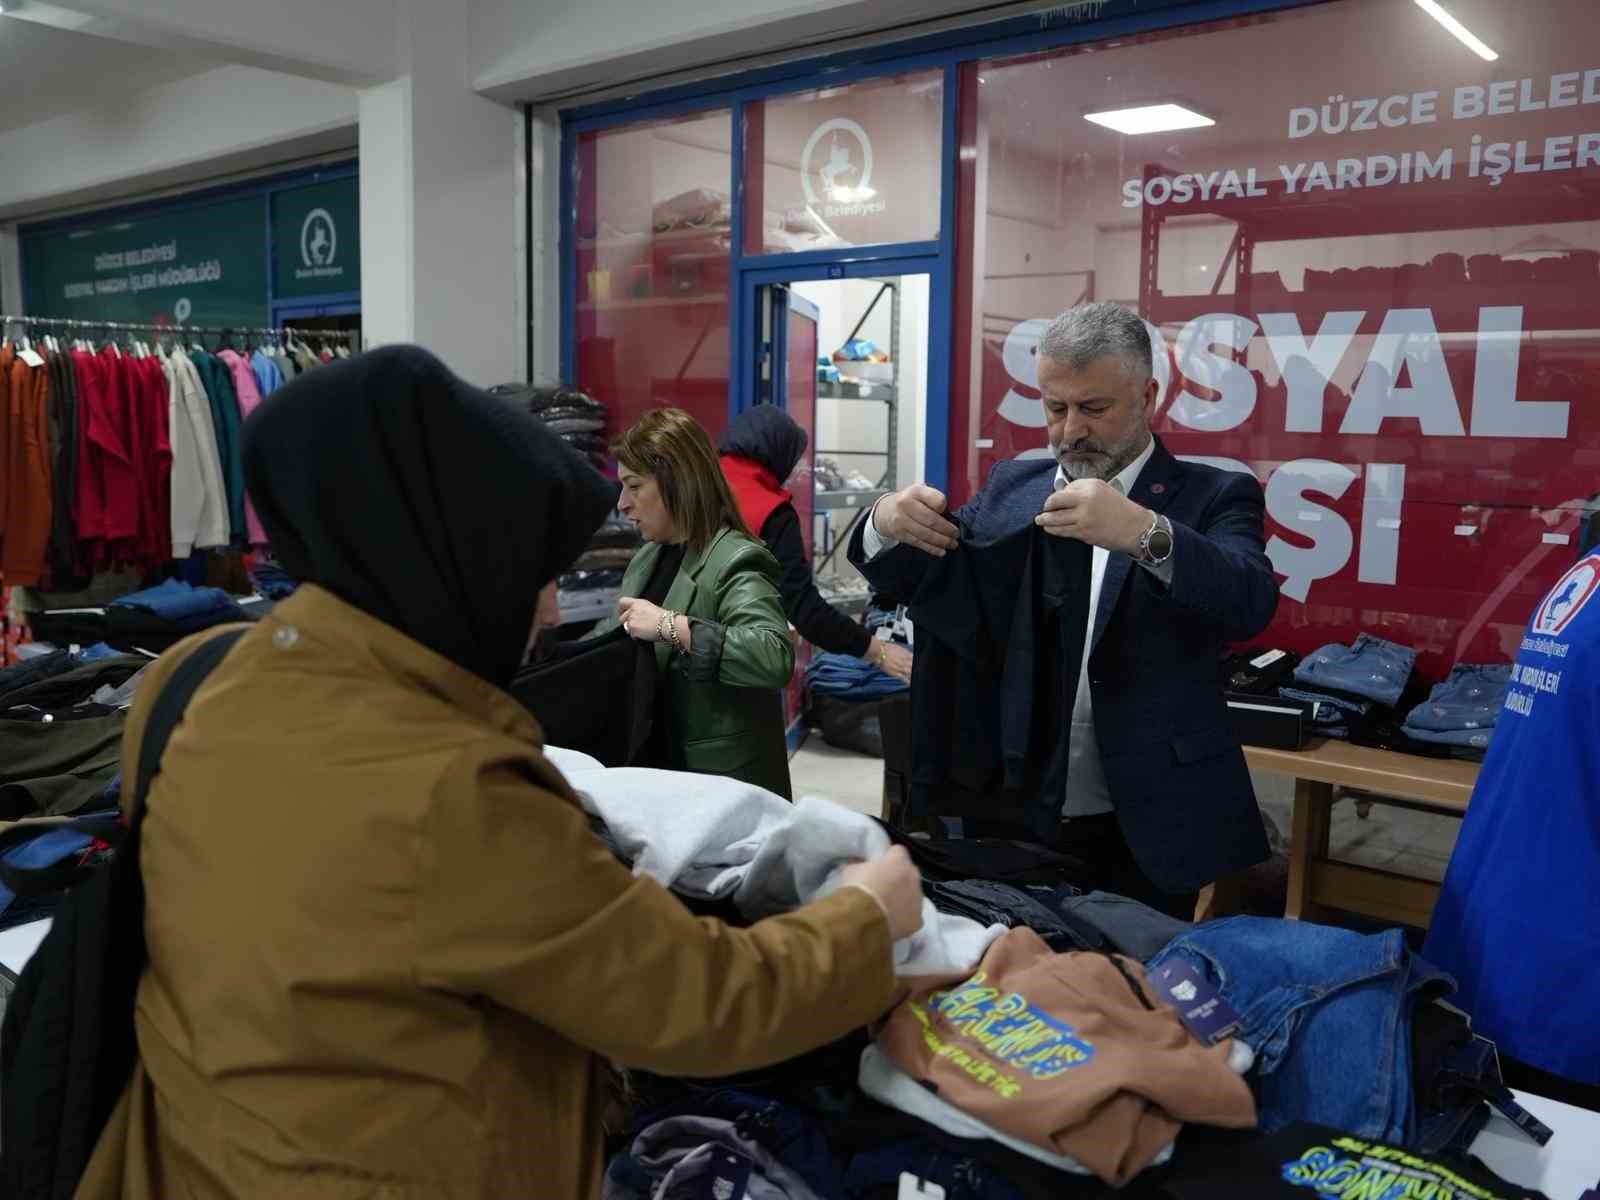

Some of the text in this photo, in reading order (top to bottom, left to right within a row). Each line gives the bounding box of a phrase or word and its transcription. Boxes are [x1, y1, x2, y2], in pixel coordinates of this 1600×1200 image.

[1288, 90, 1440, 139] DÜZCE
[1121, 132, 1600, 209] SOSYAL YARDIM İŞLER
[997, 305, 1570, 439] SSYAL
